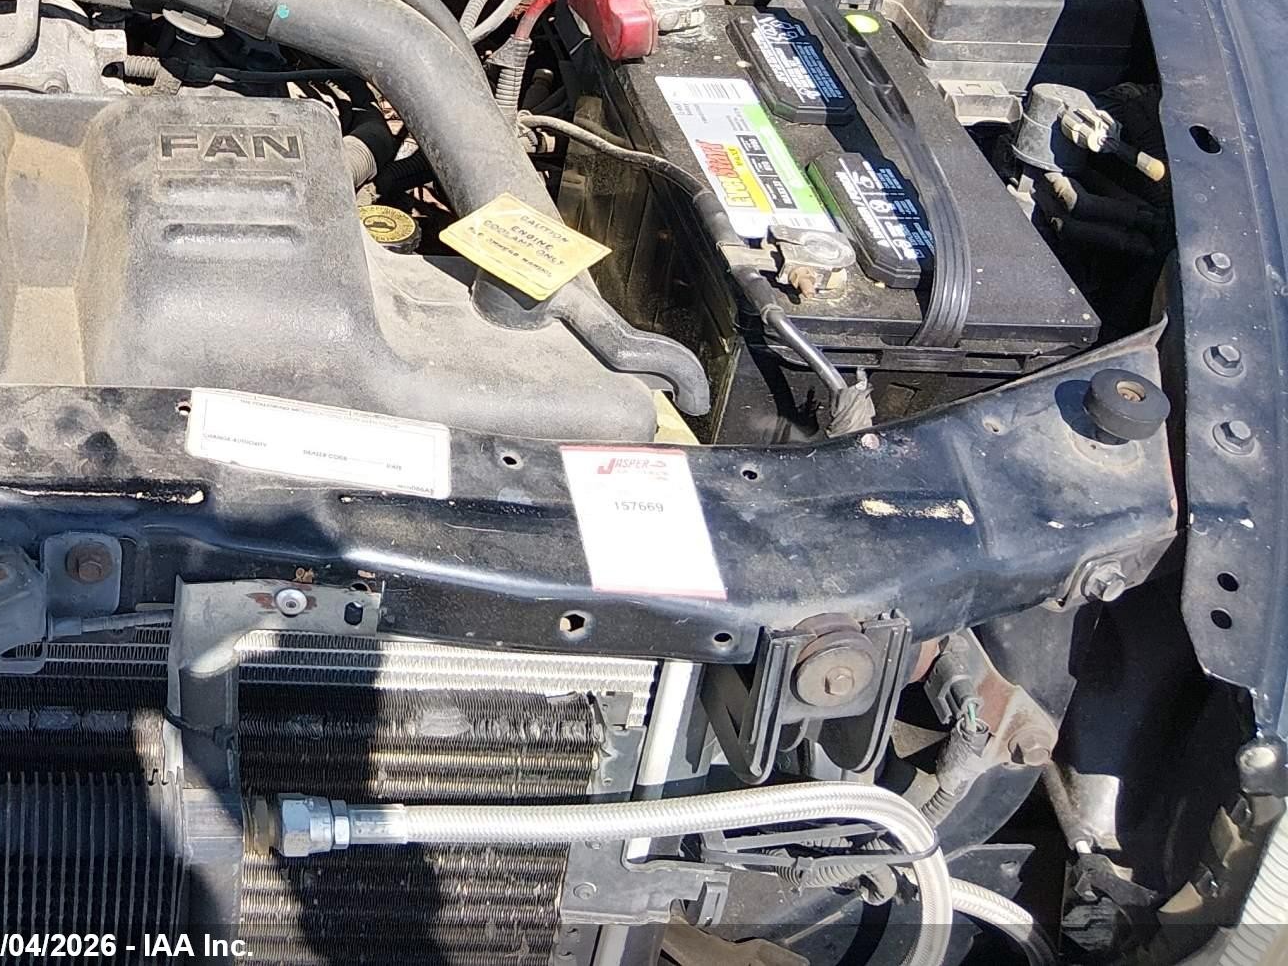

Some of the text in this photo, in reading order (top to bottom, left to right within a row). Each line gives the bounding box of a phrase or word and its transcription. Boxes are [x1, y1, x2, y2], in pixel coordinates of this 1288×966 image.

[160, 131, 302, 159] FAN
[483, 219, 565, 266] COOLANT ONLY
[511, 225, 554, 251] ENGINE
[597, 457, 650, 474] JASPER
[614, 501, 665, 513] 157669
